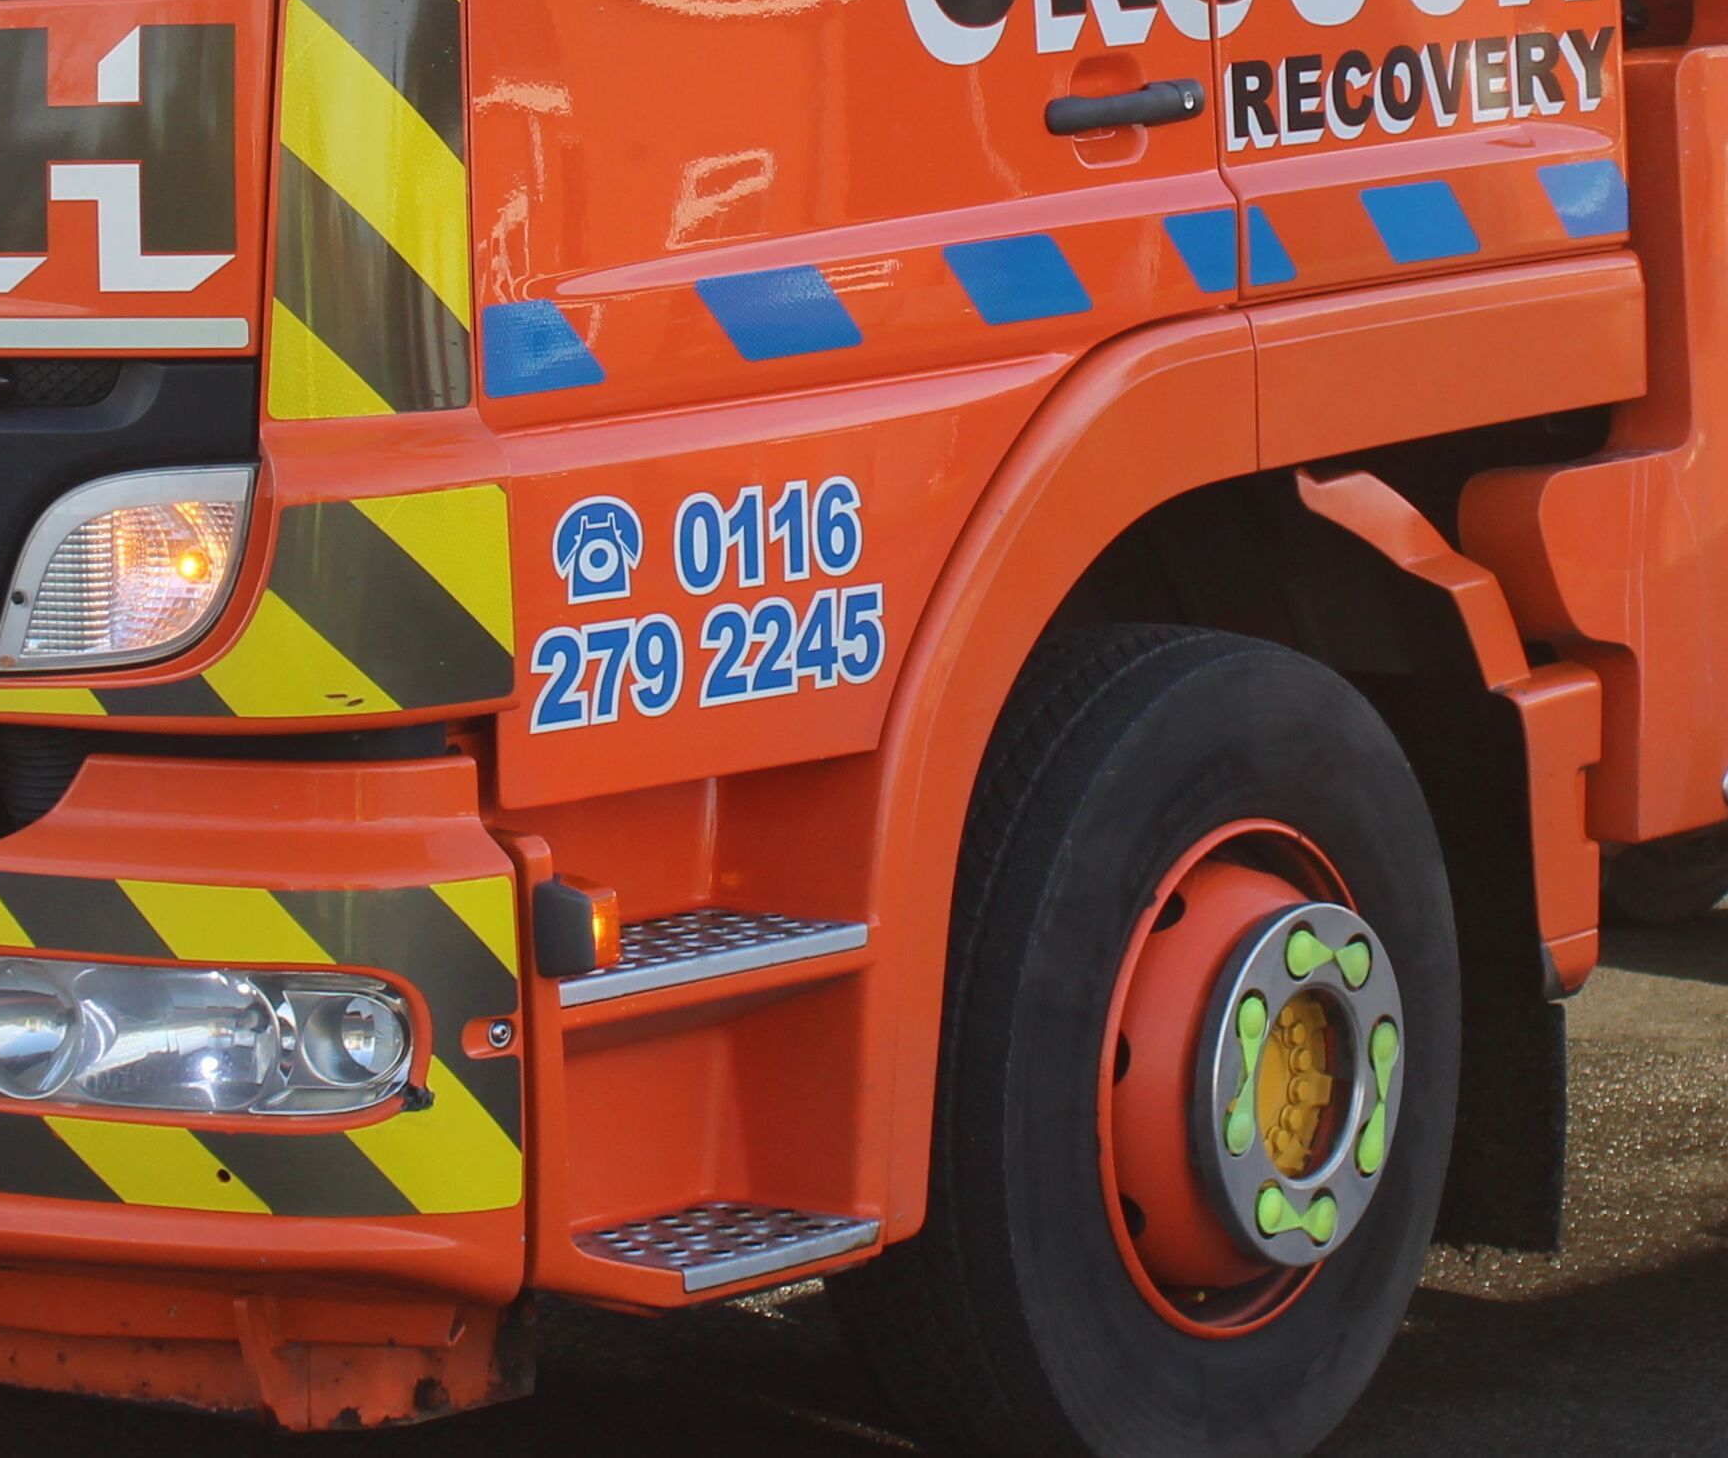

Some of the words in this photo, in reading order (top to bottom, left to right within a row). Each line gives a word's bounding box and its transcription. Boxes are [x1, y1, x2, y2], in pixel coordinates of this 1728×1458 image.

[1226, 26, 1615, 152] RECOVERY
[674, 476, 863, 596] 0116
[529, 613, 684, 735] 279
[699, 583, 885, 709] 2245
